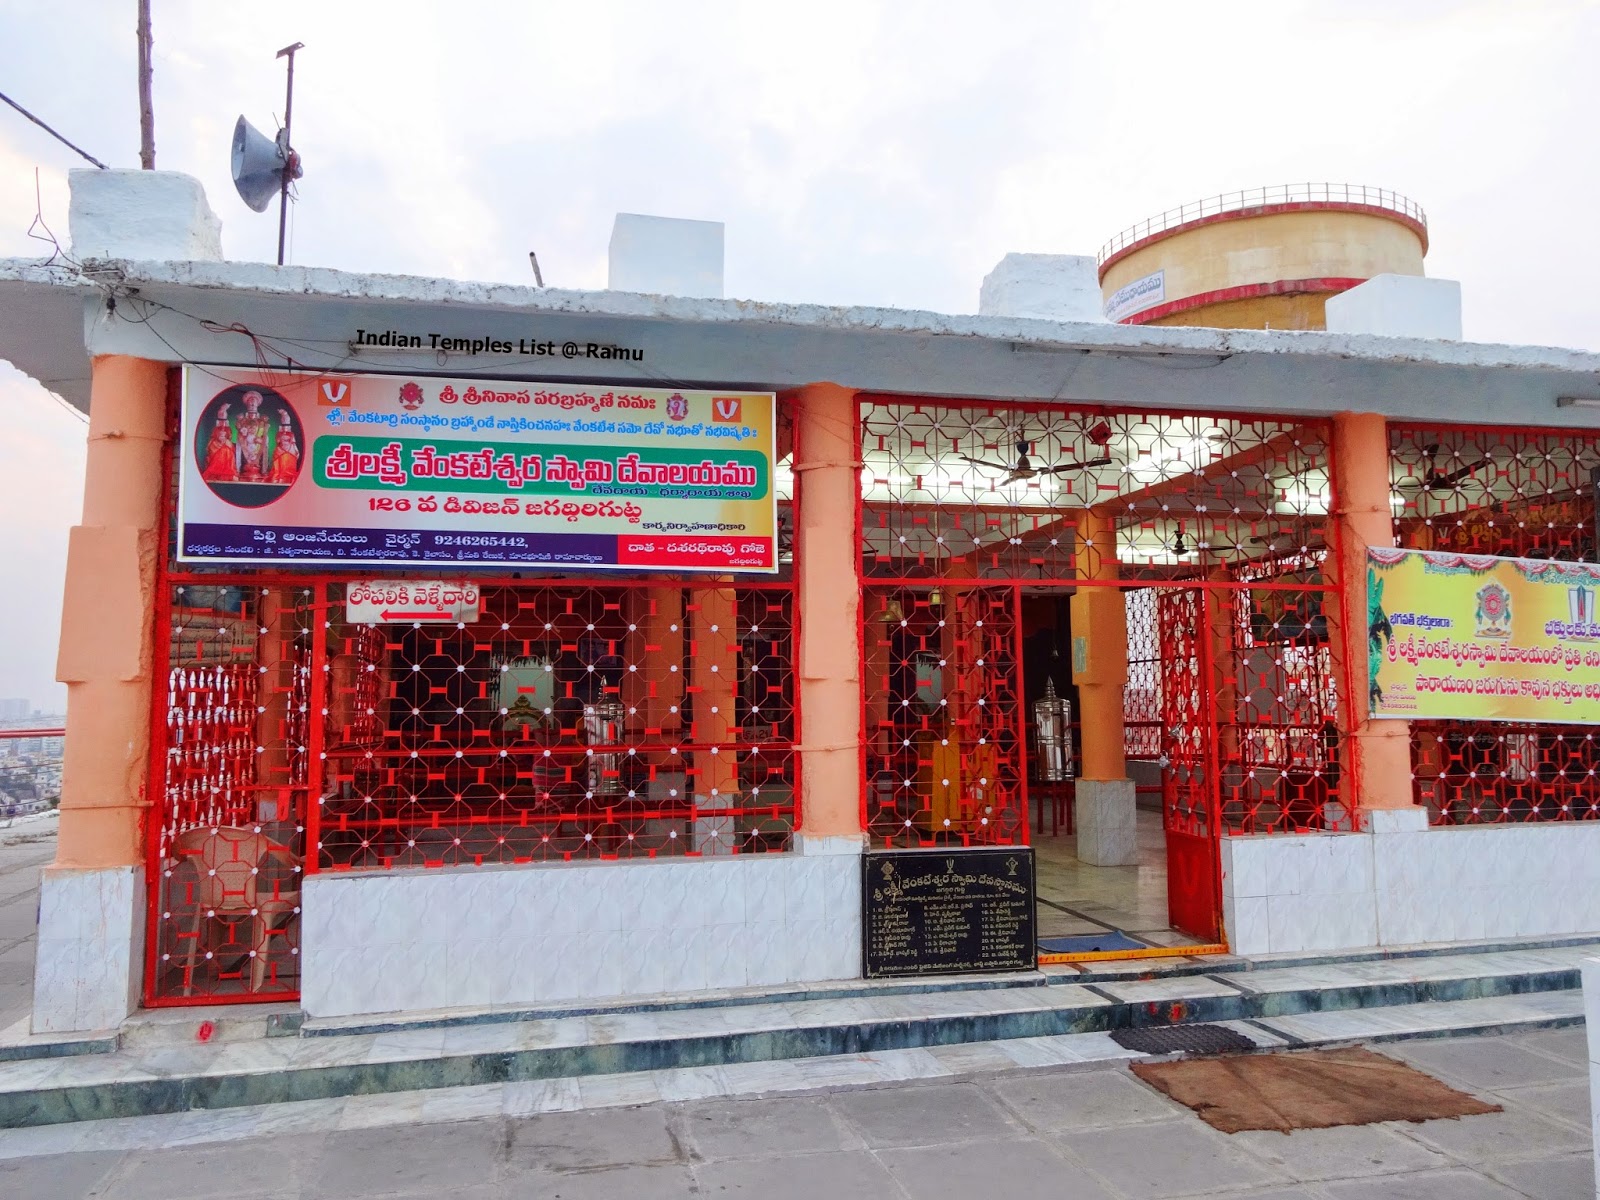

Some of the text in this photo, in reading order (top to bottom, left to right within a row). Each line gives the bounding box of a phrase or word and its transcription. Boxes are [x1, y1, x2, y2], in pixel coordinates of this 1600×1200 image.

[440, 385, 459, 404] శ్రీ
[463, 386, 531, 406] శ్రీనివాస
[412, 445, 542, 489] వేంకటేశ్వర
[546, 453, 614, 490] స్వామి
[617, 452, 757, 487] దేవాలయము
[368, 497, 411, 512] 126
[417, 494, 439, 512] వ
[443, 495, 520, 516] డివిజన్
[282, 529, 368, 544] ఆంజనేయులు
[386, 533, 421, 550] చైర్మన్
[434, 534, 529, 550] 9246265442,
[628, 542, 655, 553] దాత
[349, 585, 409, 605] లోపలికి
